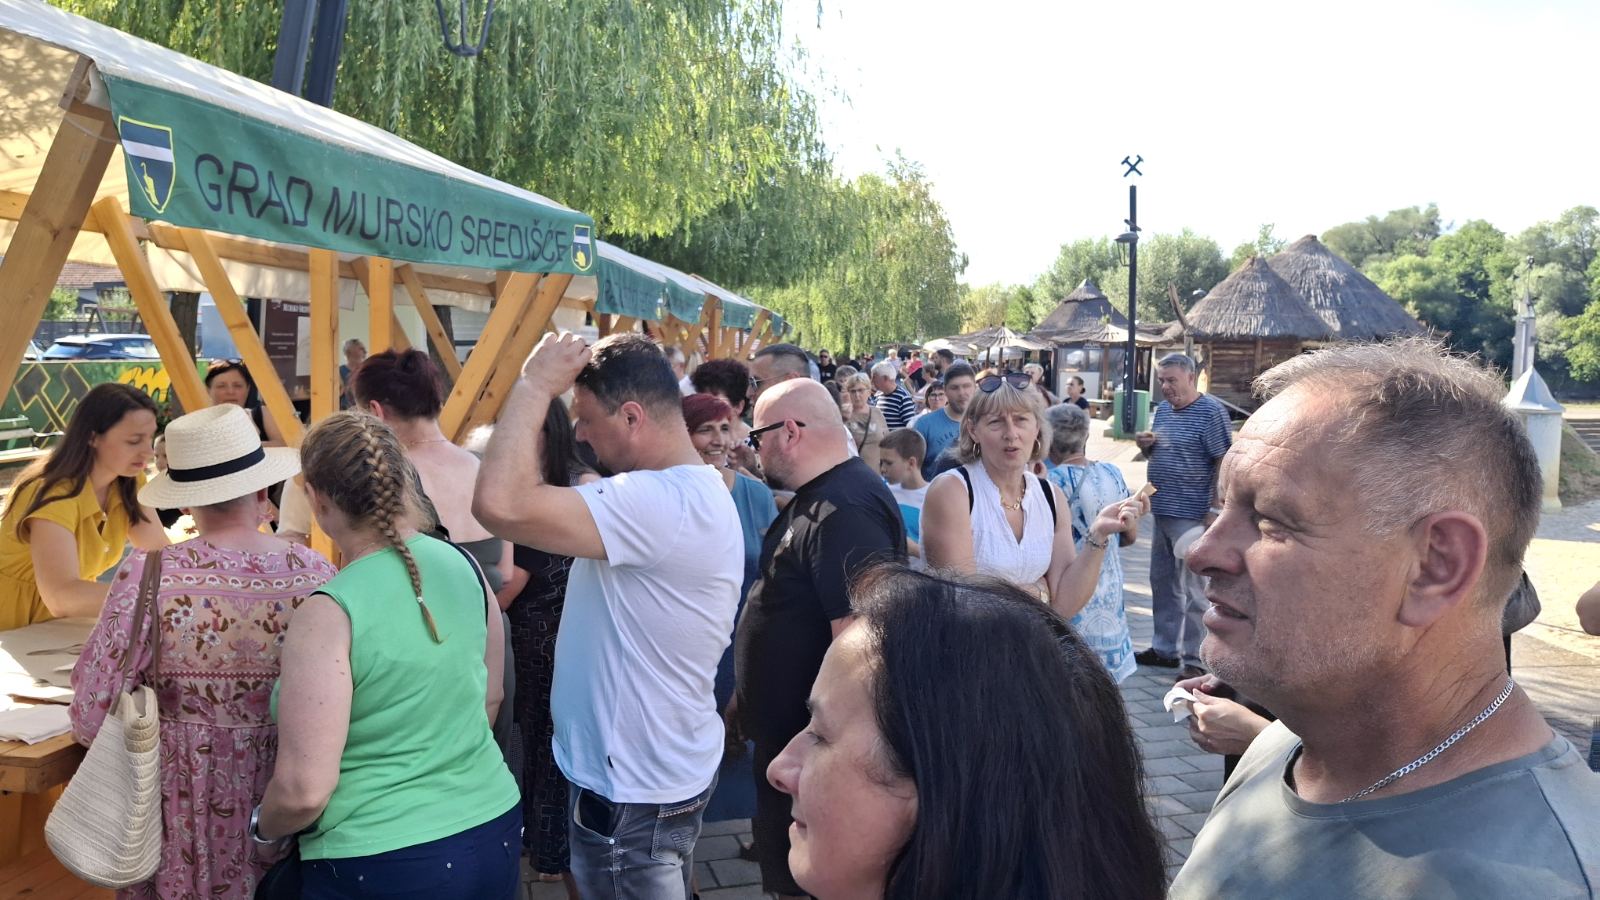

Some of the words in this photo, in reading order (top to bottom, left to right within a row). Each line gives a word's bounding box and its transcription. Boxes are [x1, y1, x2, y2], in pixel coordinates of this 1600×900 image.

[195, 153, 313, 227] GRAD
[323, 186, 453, 251] MURSKO
[460, 215, 568, 261] SREDIŠĆE
